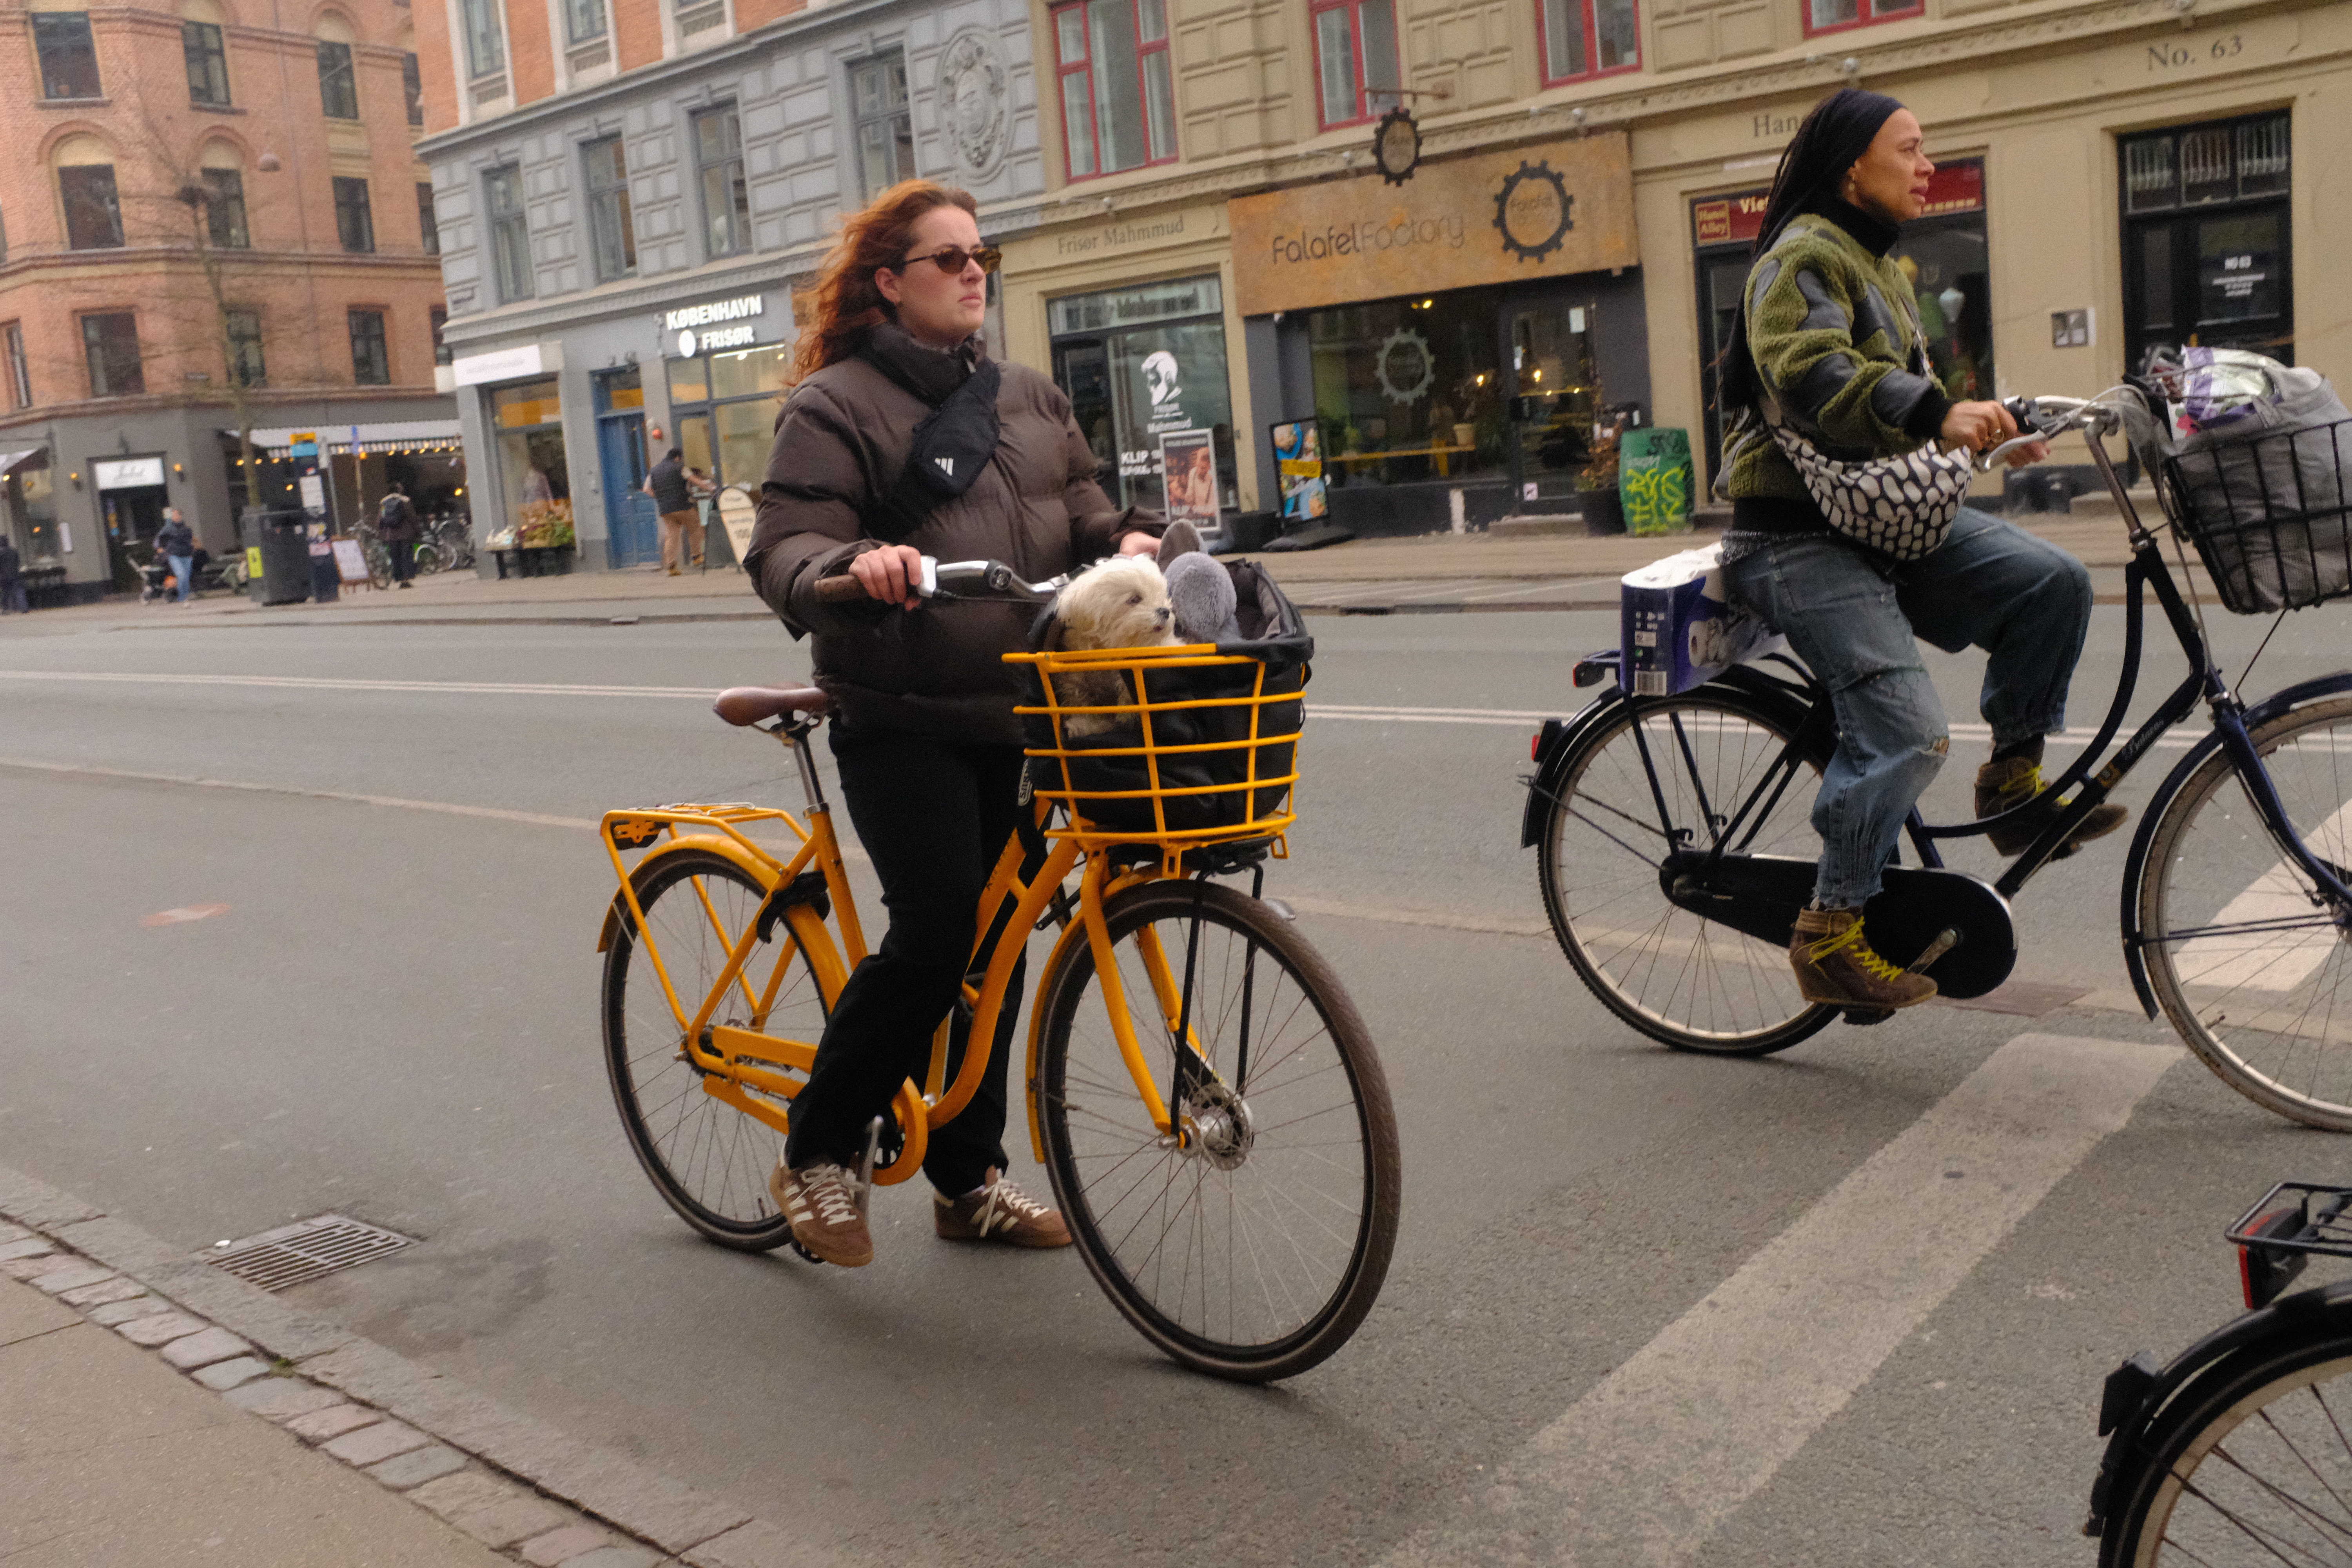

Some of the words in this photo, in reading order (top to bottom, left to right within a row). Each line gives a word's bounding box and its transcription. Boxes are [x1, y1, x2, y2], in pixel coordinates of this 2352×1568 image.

[2148, 43, 2196, 71] No.
[2210, 35, 2243, 60] 63
[1753, 114, 1806, 138] Han
[1272, 214, 1465, 264] FalafelFactory
[666, 295, 762, 330] KØBENHAVN
[702, 326, 755, 350] FRISØR
